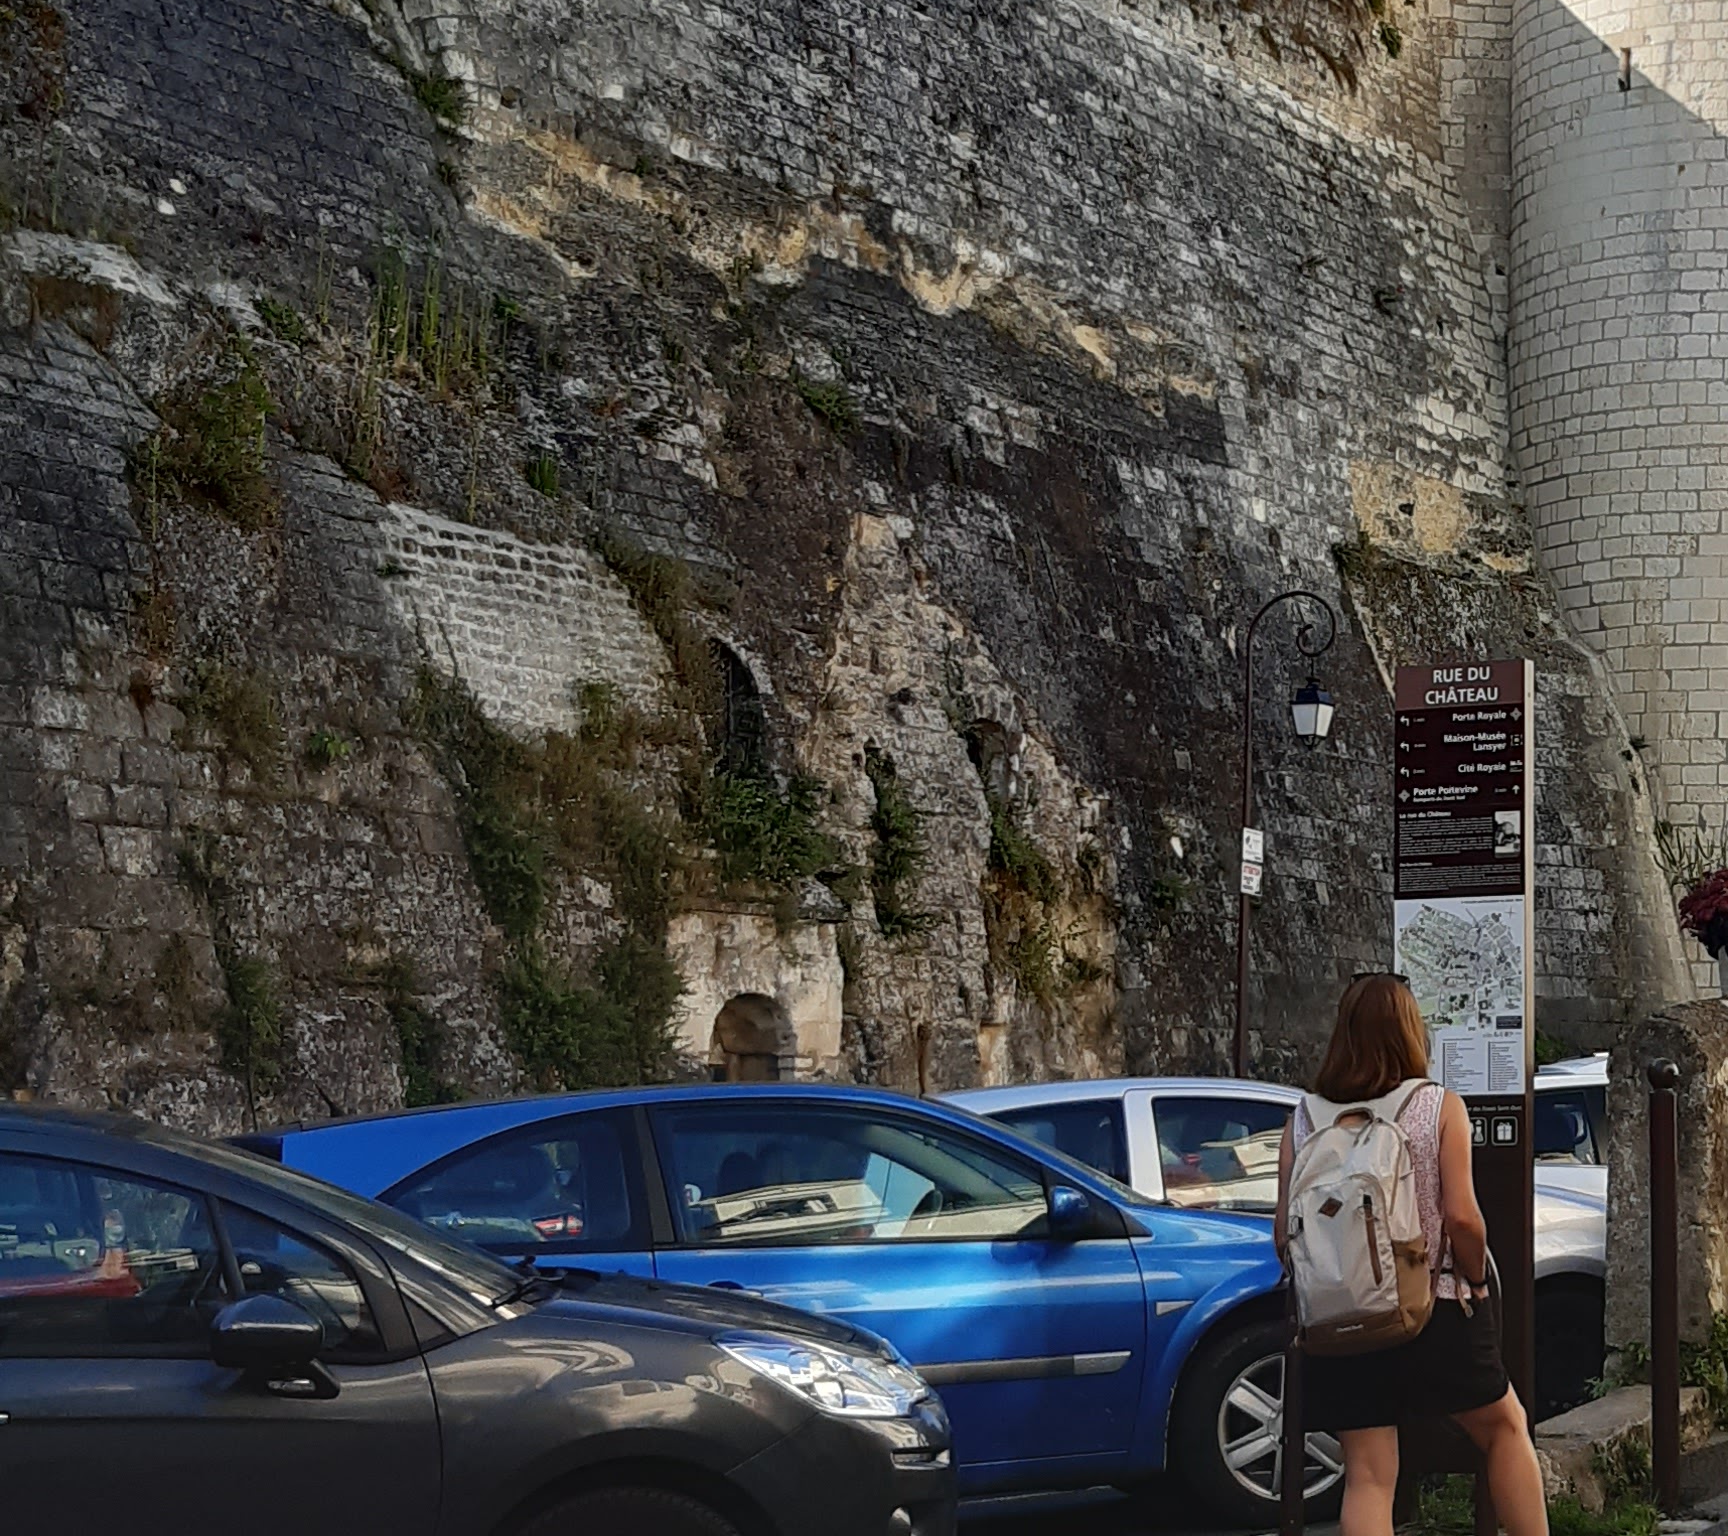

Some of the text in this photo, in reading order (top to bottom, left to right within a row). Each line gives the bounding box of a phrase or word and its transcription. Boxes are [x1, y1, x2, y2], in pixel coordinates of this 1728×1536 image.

[1433, 666, 1490, 683] RUE DU
[1425, 686, 1498, 704] CHÂTEAU
[1452, 710, 1507, 722] Porte Royale
[1443, 731, 1507, 743] Maison-Musée
[1473, 743, 1507, 752] Lansyer
[1458, 762, 1507, 773] Cité Royale
[1413, 788, 1436, 797] Porte
